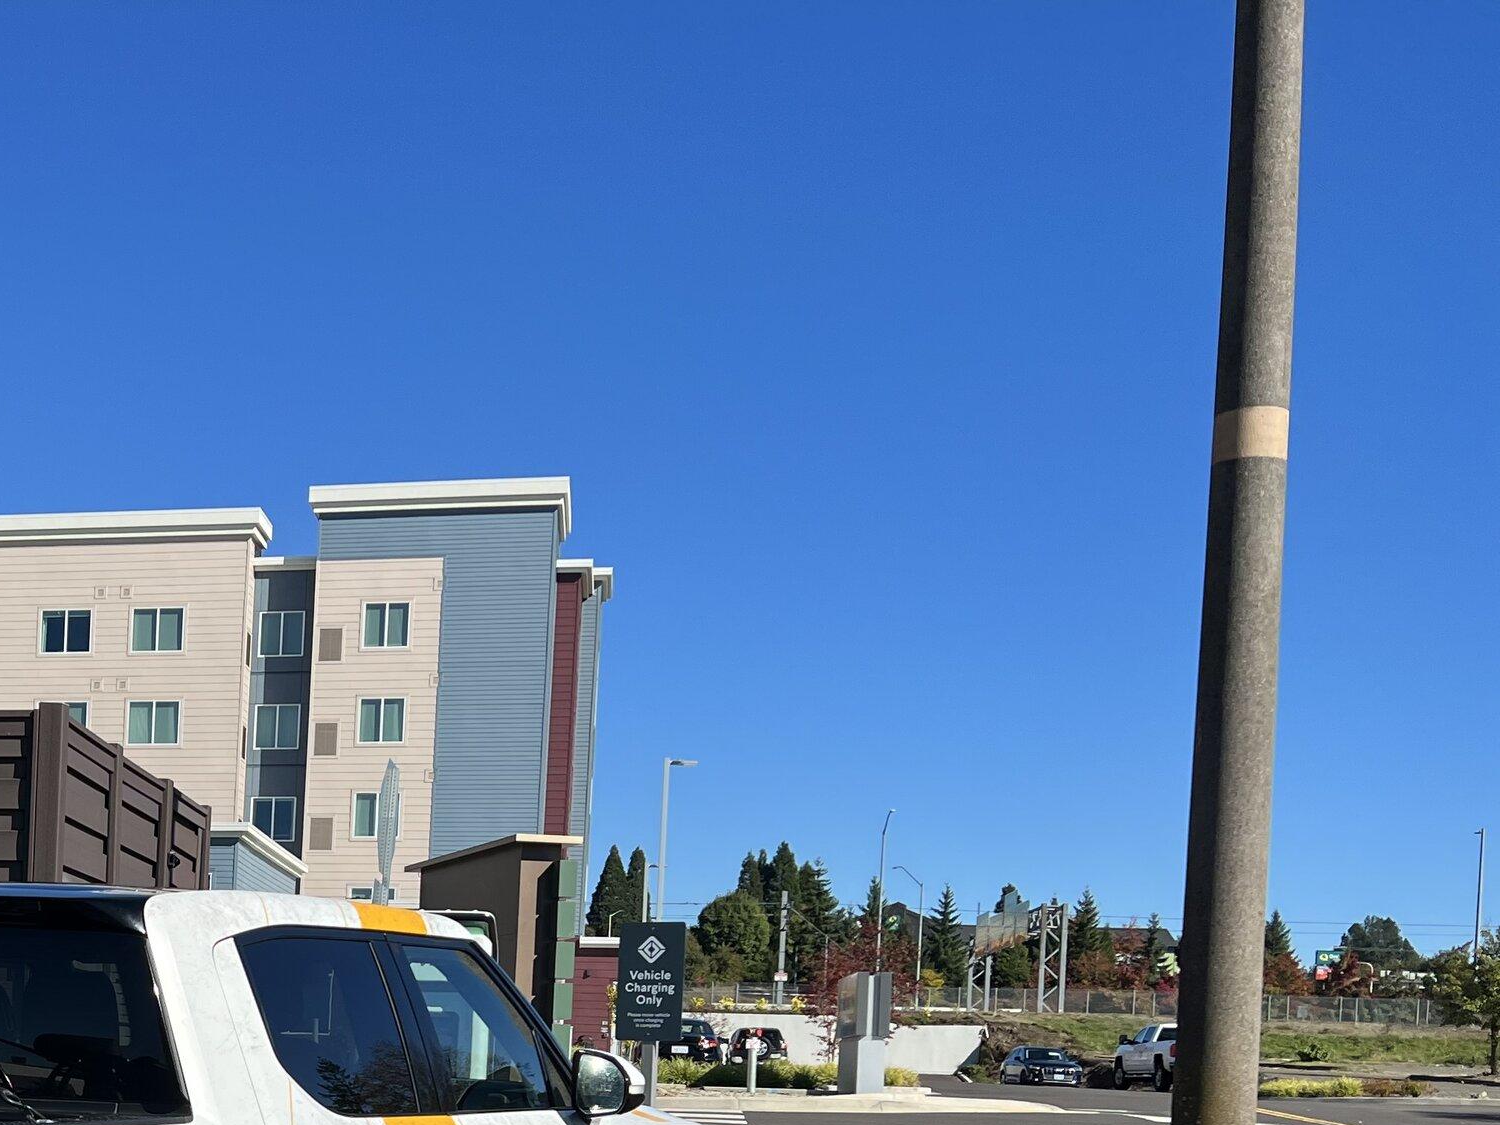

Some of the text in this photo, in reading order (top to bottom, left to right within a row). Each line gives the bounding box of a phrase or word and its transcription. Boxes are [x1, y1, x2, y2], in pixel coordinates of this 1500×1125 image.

[629, 969, 672, 980] Vehicle
[625, 982, 675, 995] Charging
[635, 994, 663, 1007] Only
